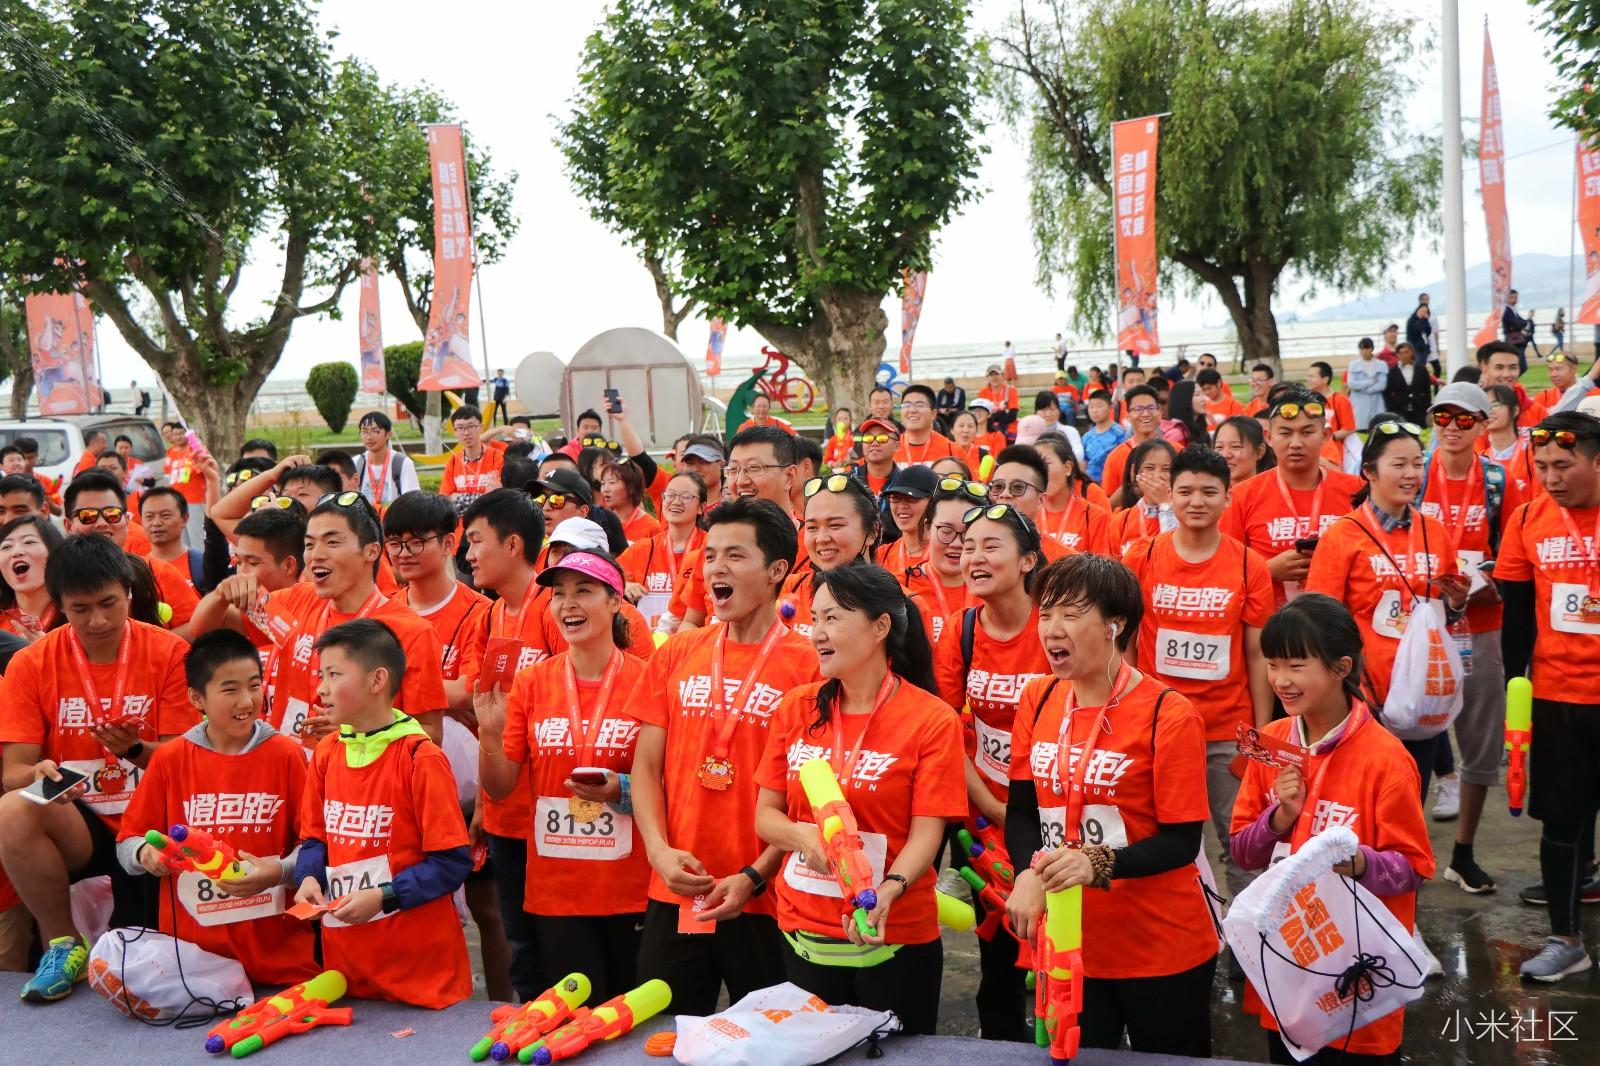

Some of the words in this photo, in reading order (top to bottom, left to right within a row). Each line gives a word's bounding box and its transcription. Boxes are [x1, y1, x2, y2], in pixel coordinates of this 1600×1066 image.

[1152, 584, 1234, 611] 橙色跑
[1167, 639, 1218, 661] 8197
[596, 749, 627, 758] RUN
[183, 793, 285, 826] 橙色跑
